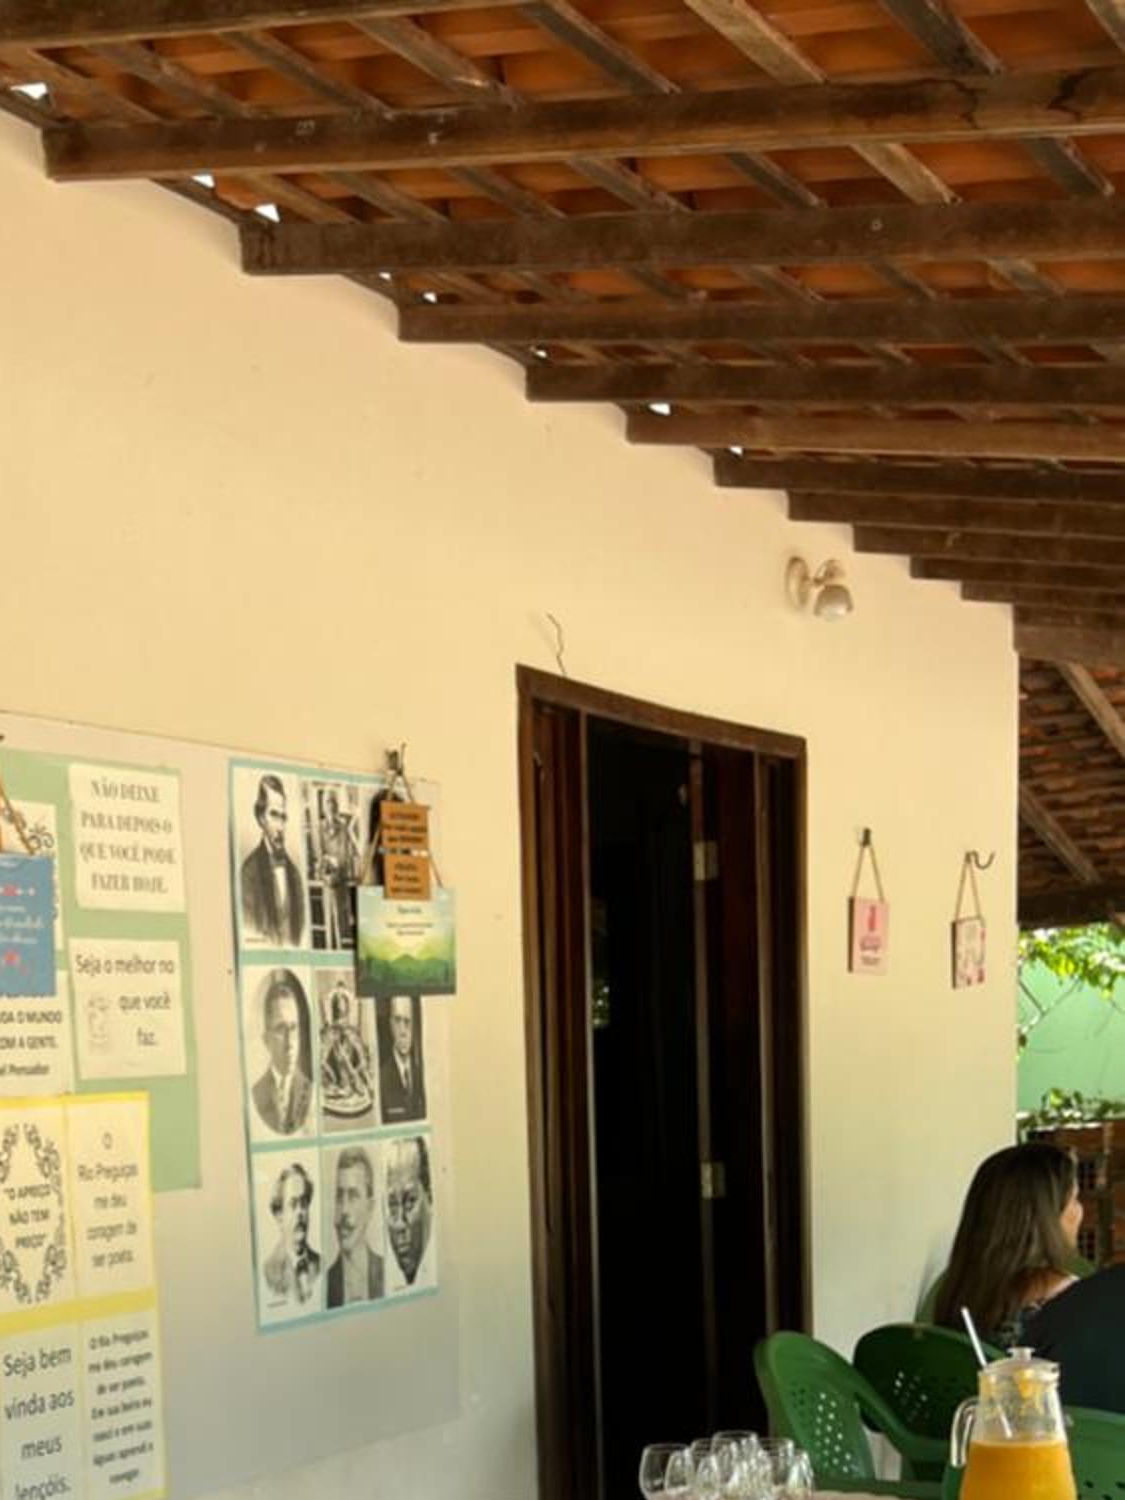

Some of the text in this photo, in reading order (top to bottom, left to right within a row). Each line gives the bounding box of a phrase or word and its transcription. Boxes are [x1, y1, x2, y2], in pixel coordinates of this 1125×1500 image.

[76, 954, 101, 977] Seja
[104, 960, 114, 974] o
[115, 955, 156, 974] melhor
[119, 992, 171, 1011] que você
[3, 1347, 72, 1378] Seja bem
[5, 1389, 75, 1421] vinda aos
[21, 1436, 63, 1460] meus
